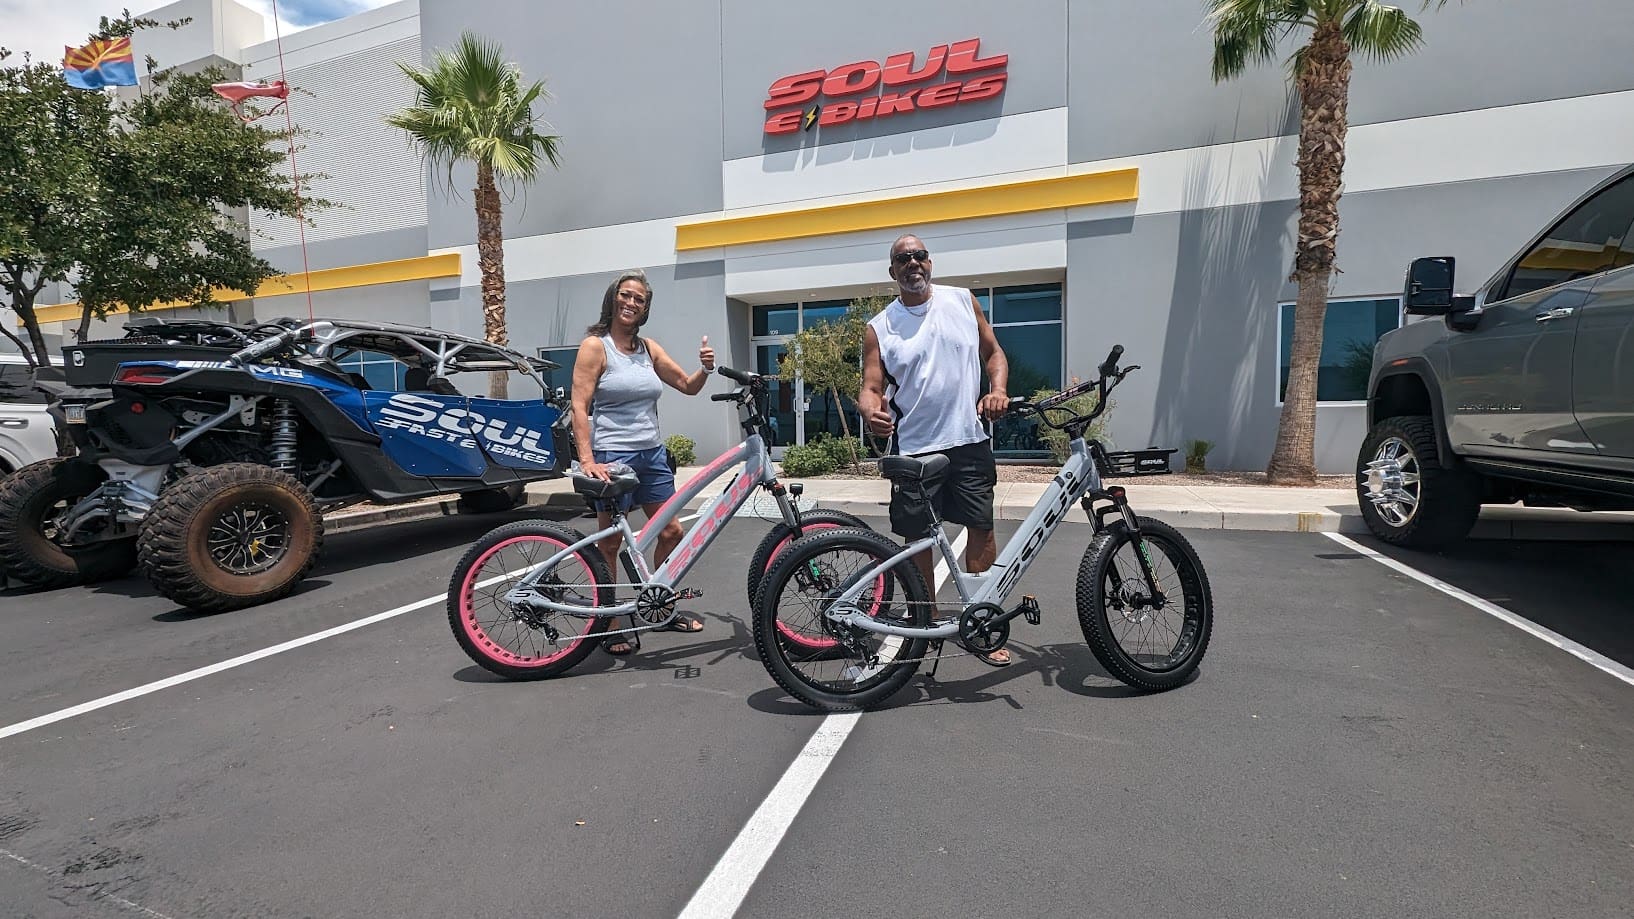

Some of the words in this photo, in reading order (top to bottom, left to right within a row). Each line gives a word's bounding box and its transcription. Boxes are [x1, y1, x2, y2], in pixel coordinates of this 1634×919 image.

[764, 38, 1008, 110] SOUL
[764, 109, 804, 135] E
[818, 72, 1008, 127] BIKES
[379, 393, 550, 455] SOUL
[490, 443, 548, 464] BIKES
[997, 467, 1091, 599] SOUL
